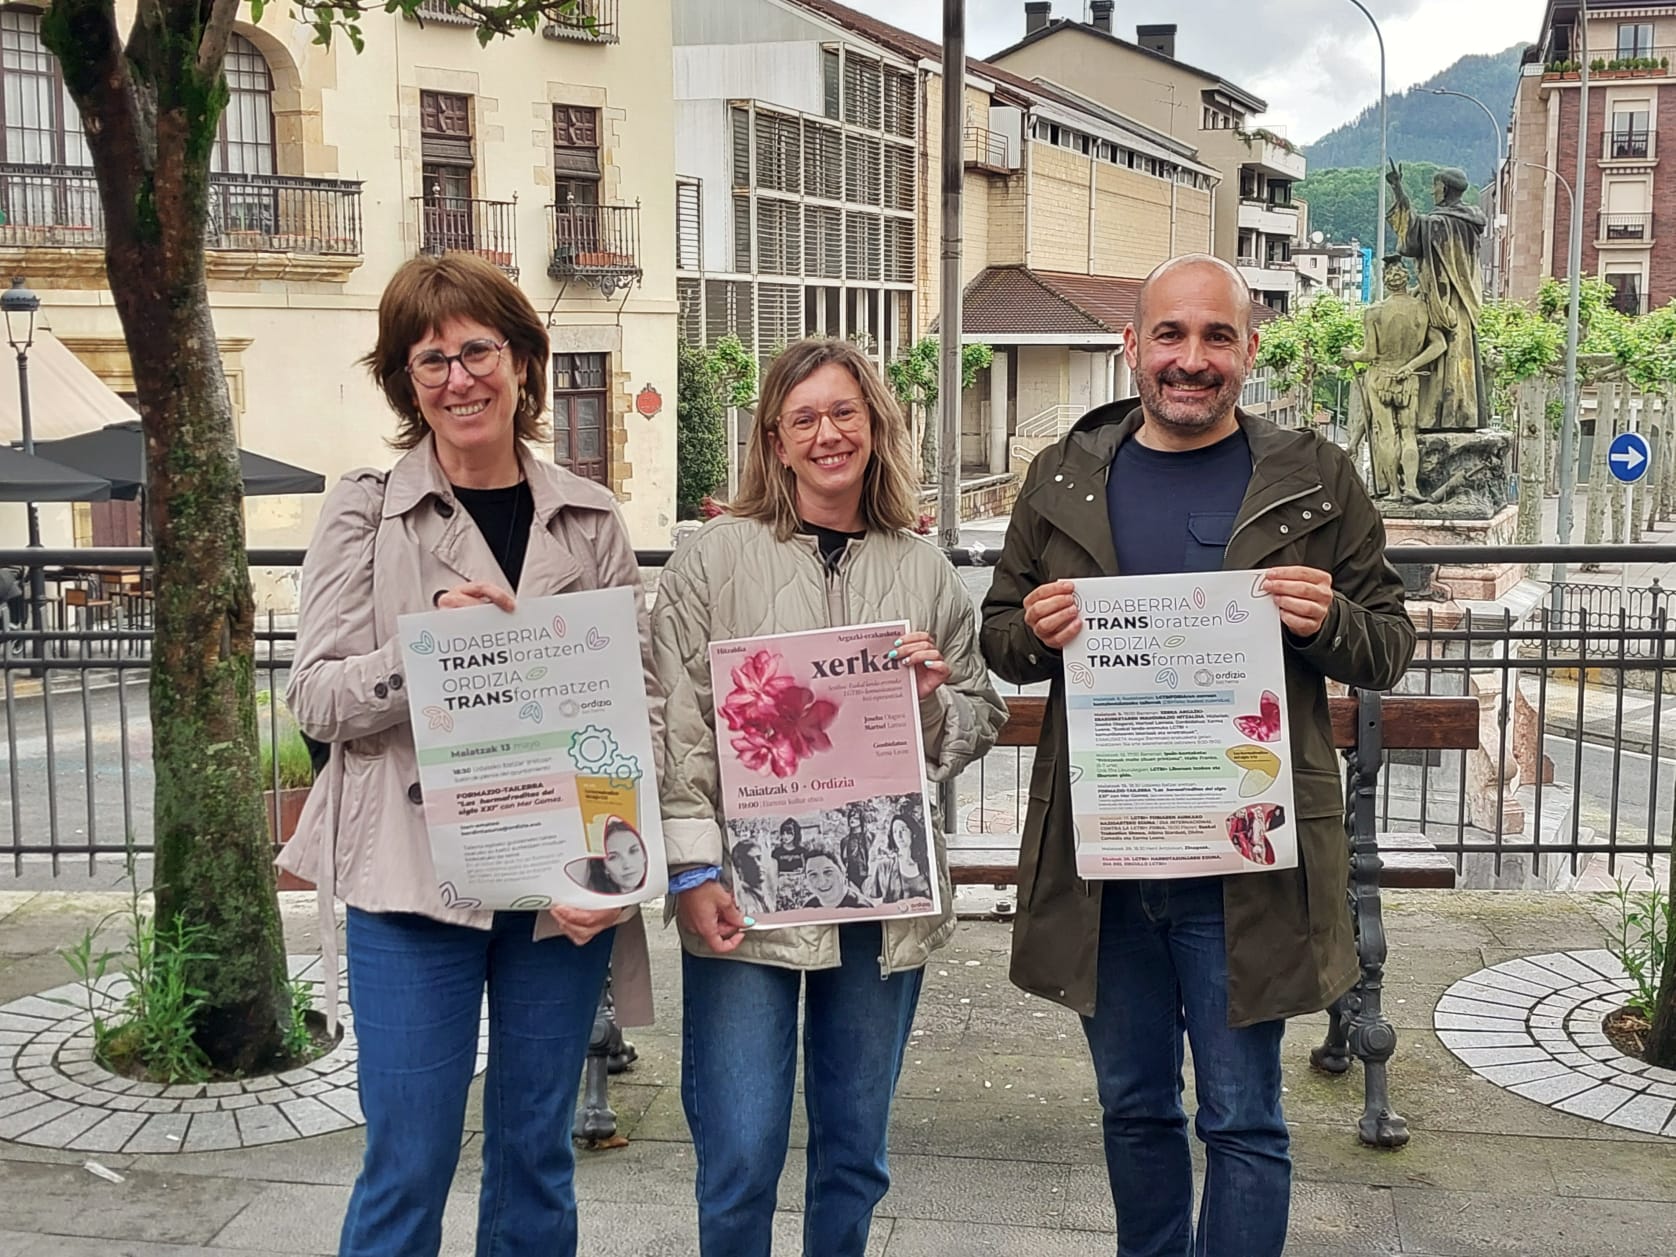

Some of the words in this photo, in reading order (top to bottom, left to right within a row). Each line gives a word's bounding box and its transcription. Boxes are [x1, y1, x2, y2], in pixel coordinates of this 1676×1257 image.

[1084, 596, 1191, 614] UDABERRIA
[1085, 613, 1223, 630] TRANSloratzen
[437, 627, 552, 654] UDABERRIA
[1086, 636, 1161, 651] ORDIZIA
[439, 641, 585, 672] TRANSloratzen
[811, 649, 900, 679] xerka
[1087, 651, 1246, 668] TRANSformatzen
[442, 670, 523, 693] ORDIZIA
[1215, 670, 1246, 679] ordizia
[444, 678, 610, 711] TRANSformatzen
[581, 700, 612, 709] ordizia
[451, 744, 498, 758] Maiatzak
[500, 743, 511, 753] 13
[738, 784, 788, 798] Maiatzak
[791, 781, 799, 793] 9
[811, 777, 854, 791] Ordizia
[500, 802, 515, 810] con
